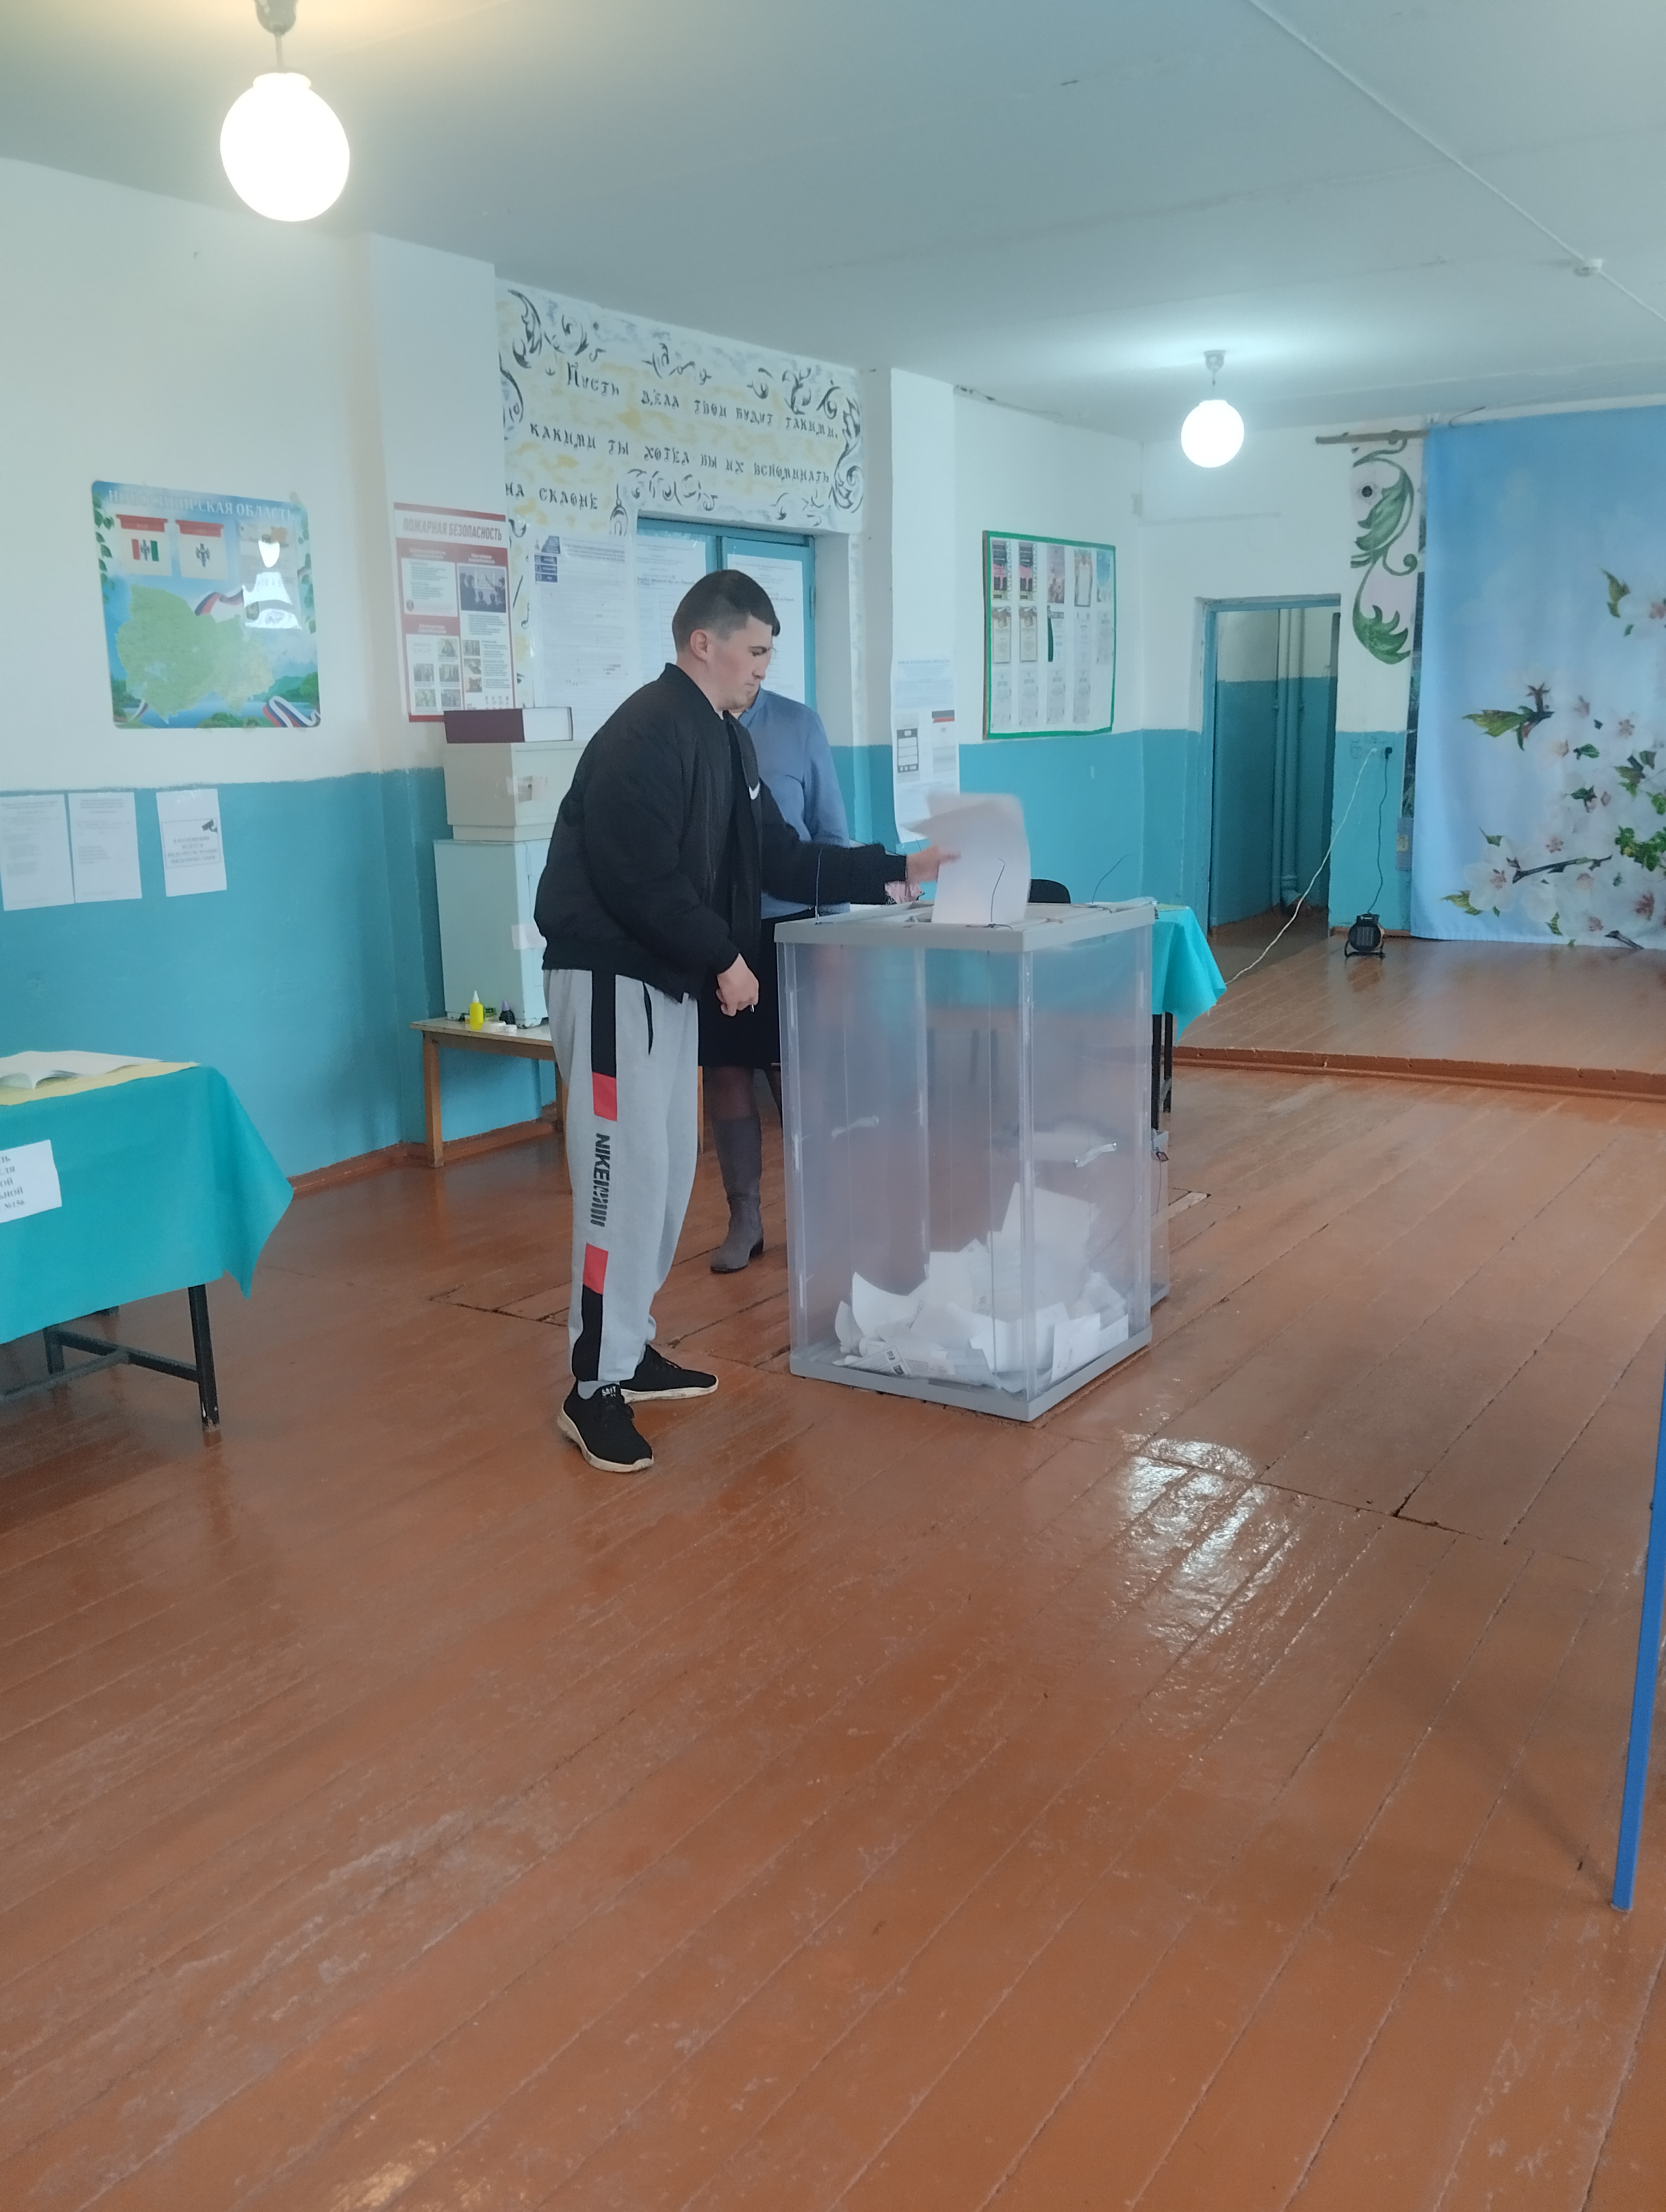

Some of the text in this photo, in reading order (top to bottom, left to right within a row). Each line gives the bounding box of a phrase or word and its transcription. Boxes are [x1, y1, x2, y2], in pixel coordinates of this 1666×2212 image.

[694, 400, 727, 418] ТВОИ
[735, 407, 773, 426] БУДУТ
[530, 422, 596, 451] КАКИМИ
[608, 439, 629, 455] ТЫ
[644, 446, 689, 466] ХОТЕЛ
[725, 458, 744, 475] ИХ
[754, 462, 829, 484] ВСПОМИНАТЬ
[505, 482, 598, 510] НА СКЛОНЕ
[236, 503, 295, 521] ОБЛАСТЬ
[403, 518, 502, 541] ПОЖАРНАЯ БЕЗОПАСНОСТЬ
